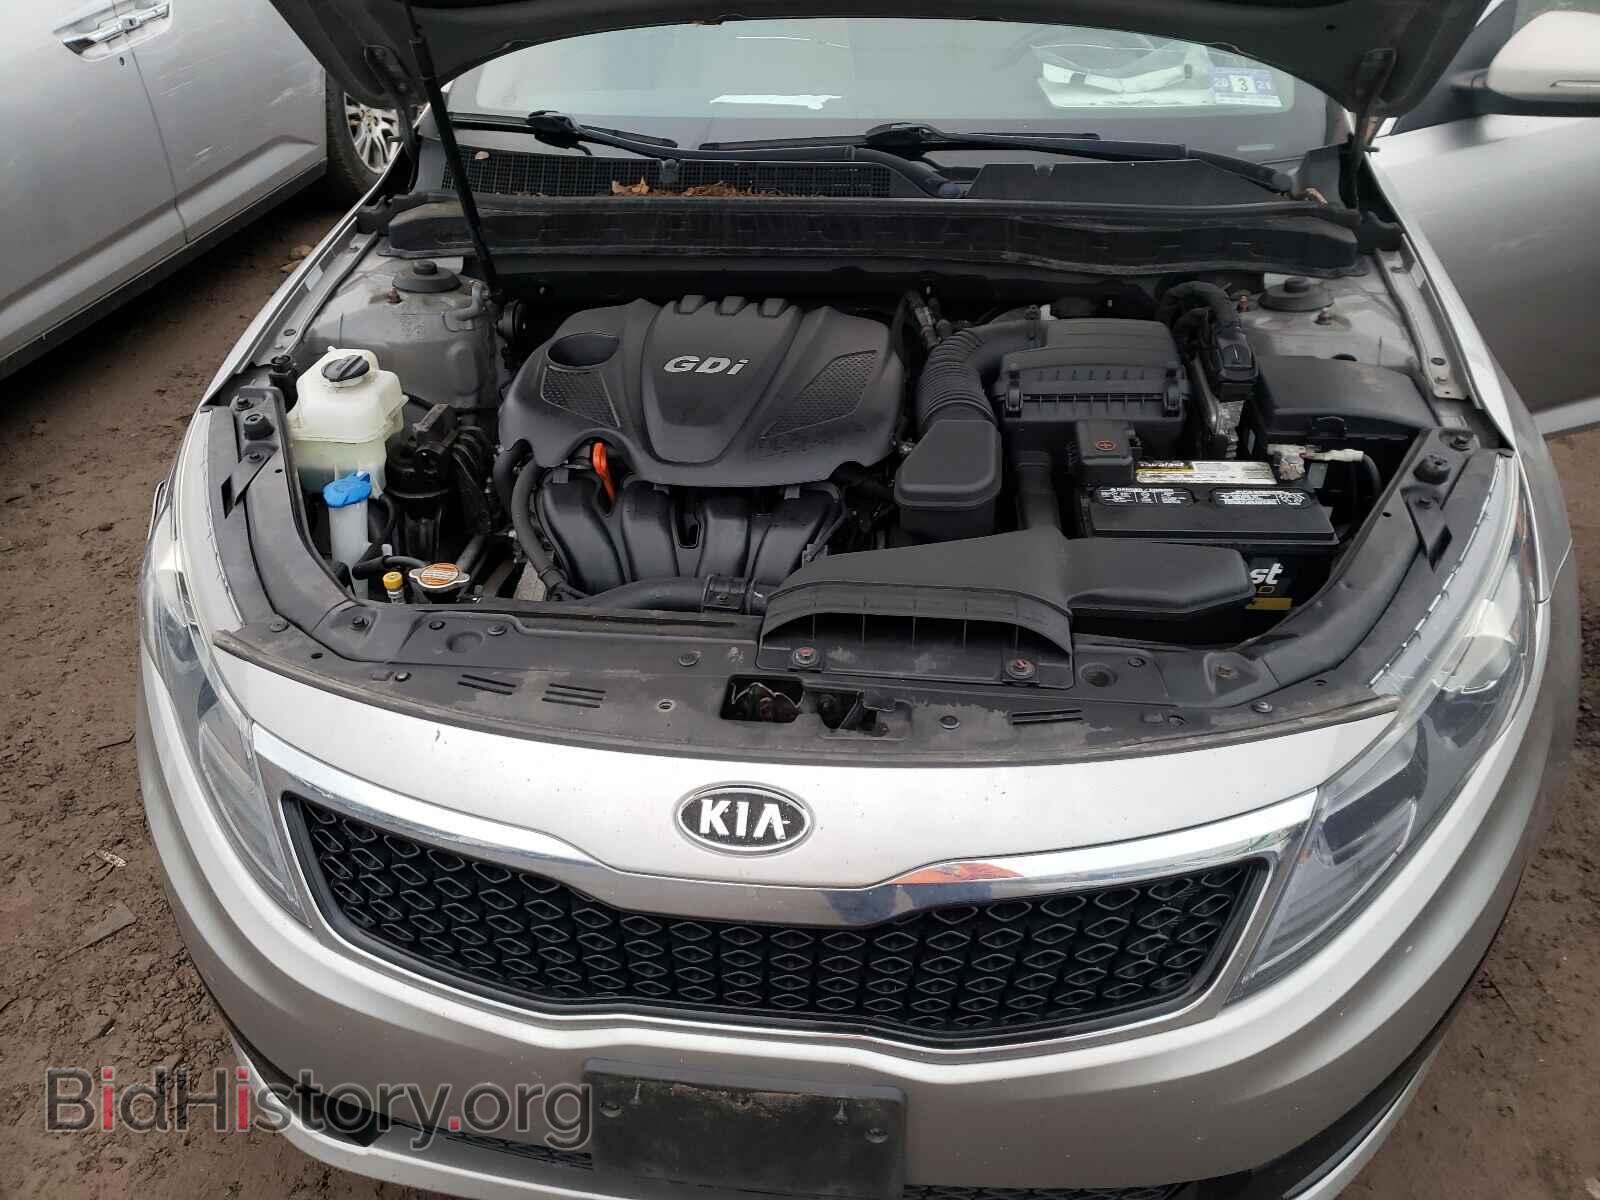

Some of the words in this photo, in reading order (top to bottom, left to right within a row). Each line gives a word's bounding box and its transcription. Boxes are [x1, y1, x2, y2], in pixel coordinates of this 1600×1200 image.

[1238, 78, 1249, 92] 3
[663, 355, 750, 375] GDi
[699, 798, 788, 841] KIA
